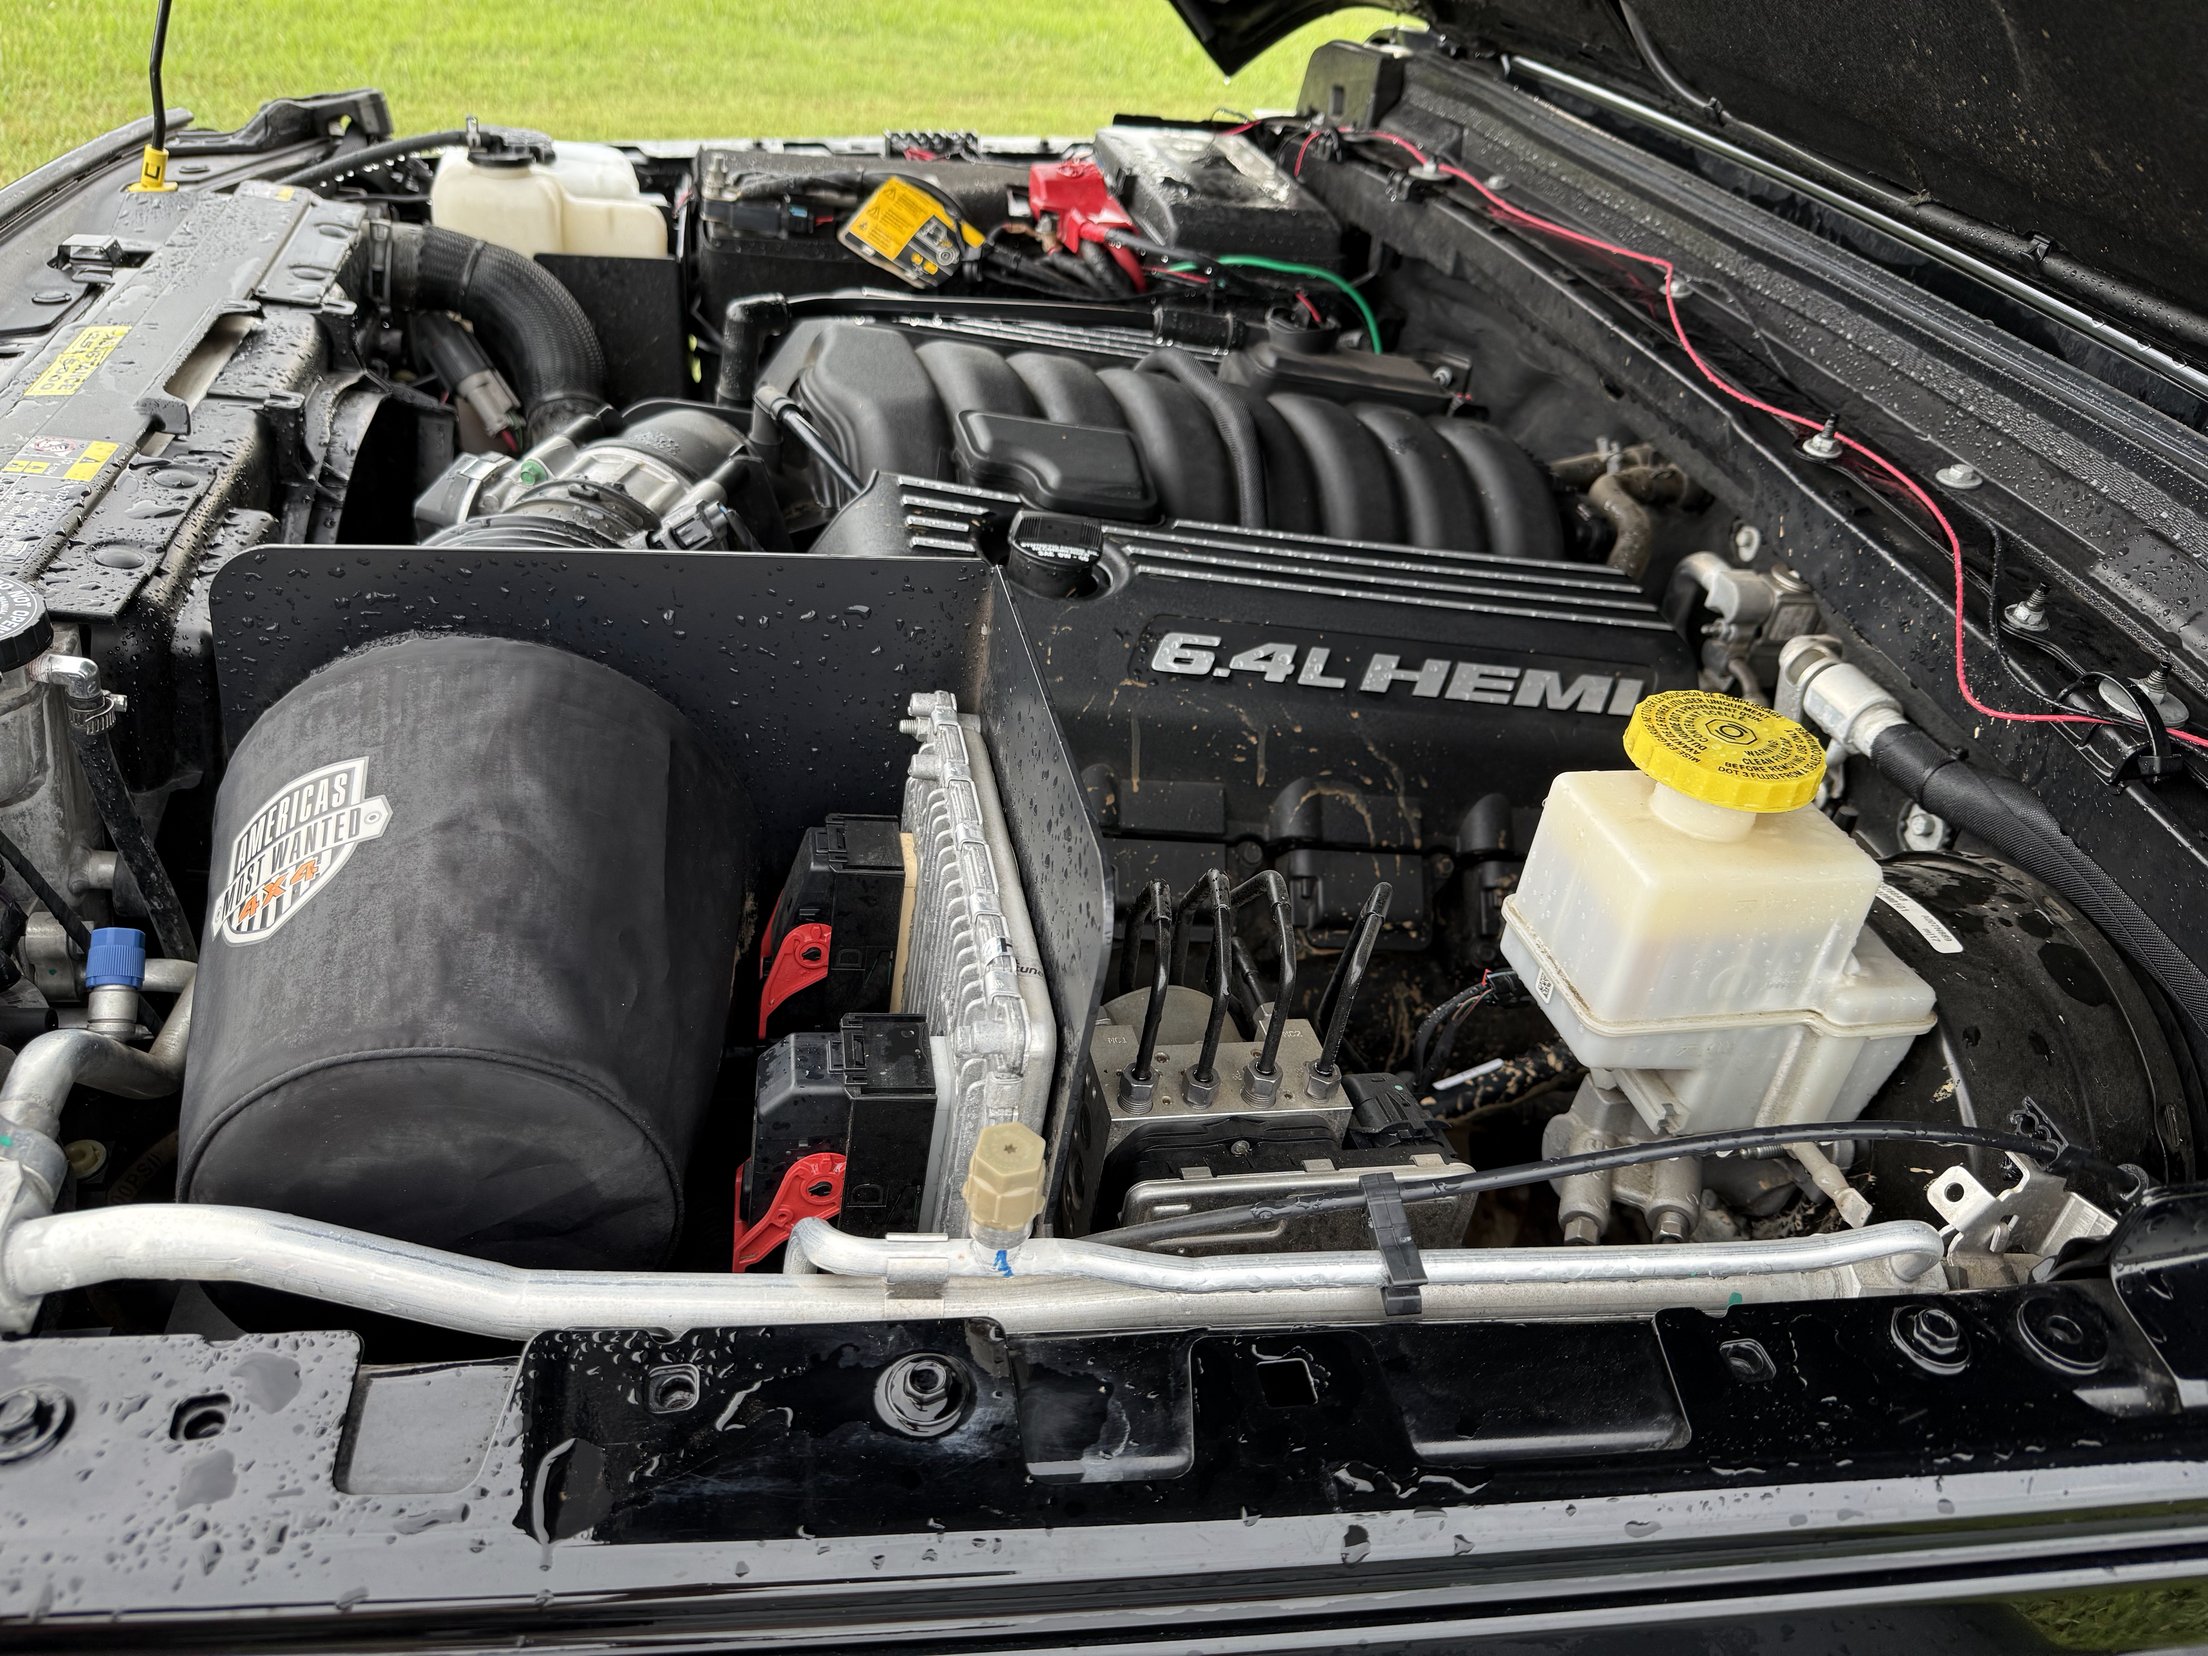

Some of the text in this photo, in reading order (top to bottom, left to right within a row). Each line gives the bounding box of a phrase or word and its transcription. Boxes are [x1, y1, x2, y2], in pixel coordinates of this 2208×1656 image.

[8, 590, 31, 608] NOT
[1151, 632, 1645, 716] 6.4L HEMI
[1724, 760, 1768, 772] BEFORE
[222, 807, 362, 918] MOST WANTED
[236, 772, 348, 874] AMERICAS
